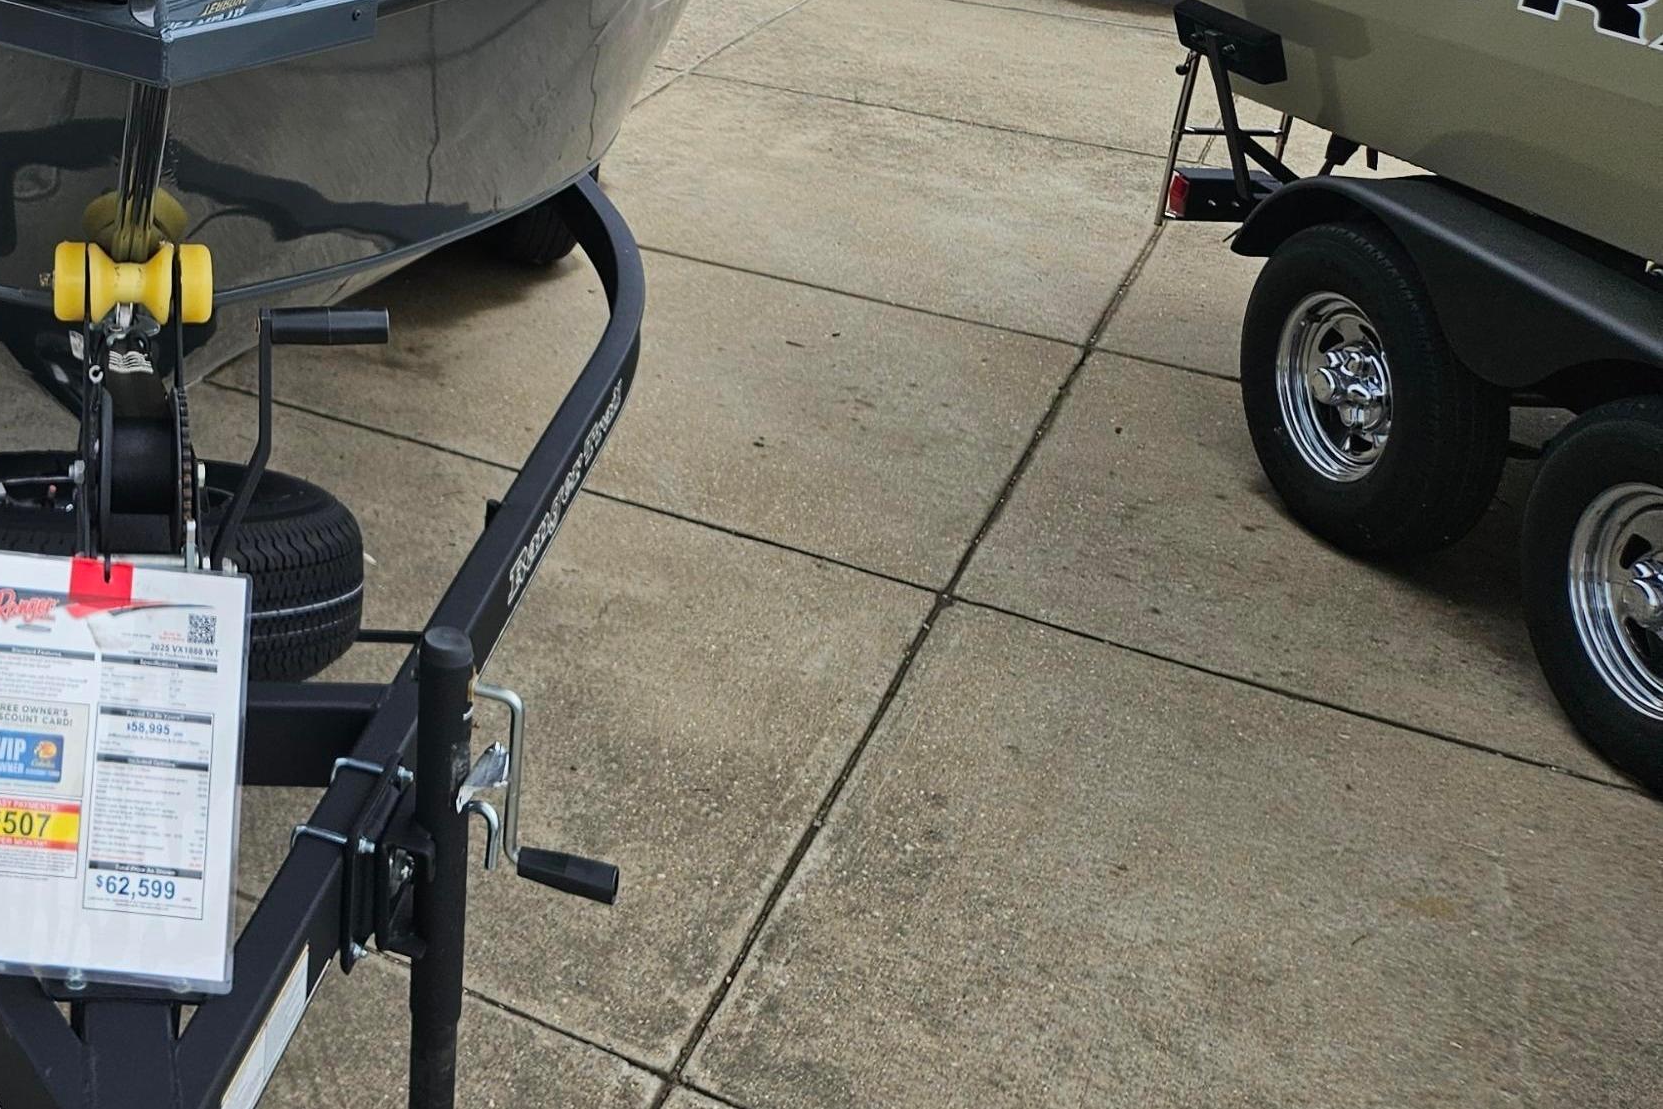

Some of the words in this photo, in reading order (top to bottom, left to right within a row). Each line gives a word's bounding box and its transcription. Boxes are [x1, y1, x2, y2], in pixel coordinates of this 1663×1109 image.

[22, 704, 69, 717] OWNER'S
[42, 715, 74, 727] CARD!
[126, 720, 171, 736] $58,995
[95, 873, 176, 900] $62,599
